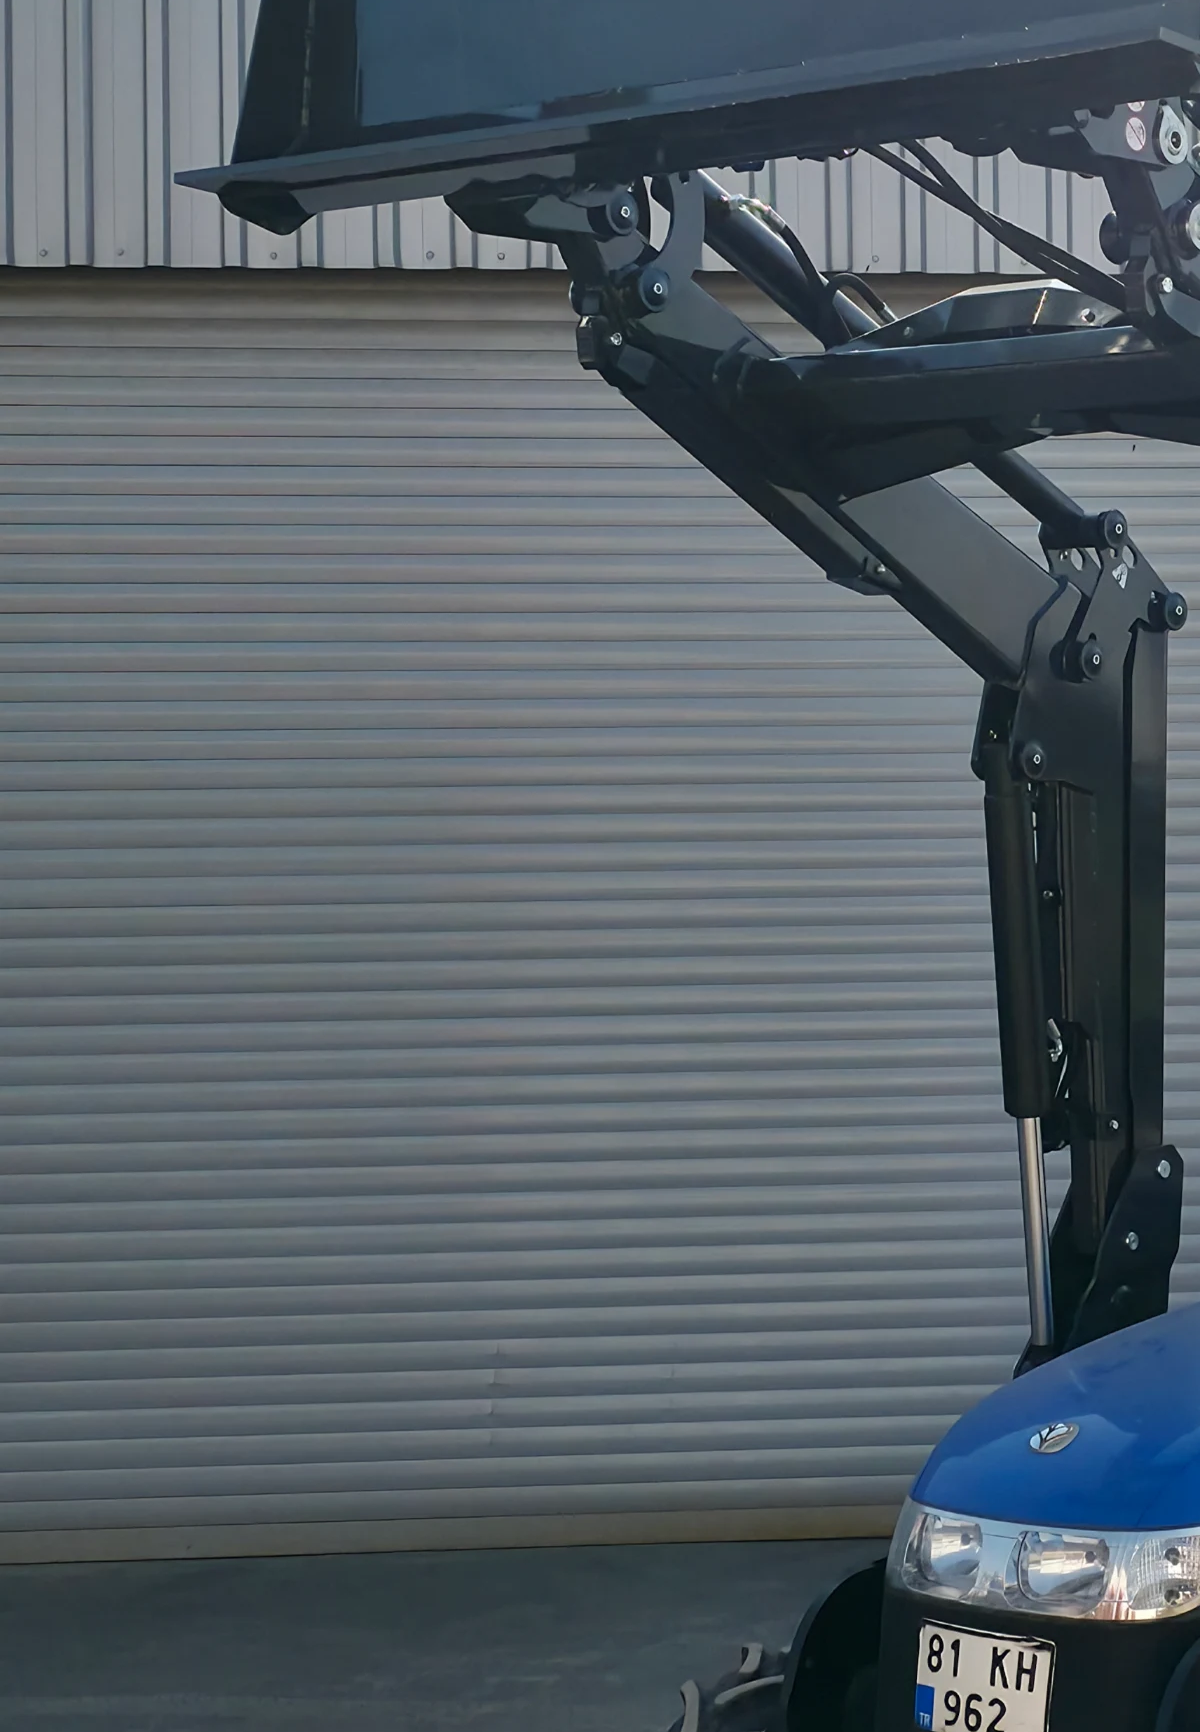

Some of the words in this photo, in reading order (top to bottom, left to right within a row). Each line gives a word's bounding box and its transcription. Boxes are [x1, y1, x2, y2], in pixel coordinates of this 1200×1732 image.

[927, 1633, 961, 1678] 81
[989, 1646, 1038, 1693] KH
[919, 1712, 931, 1727] TR
